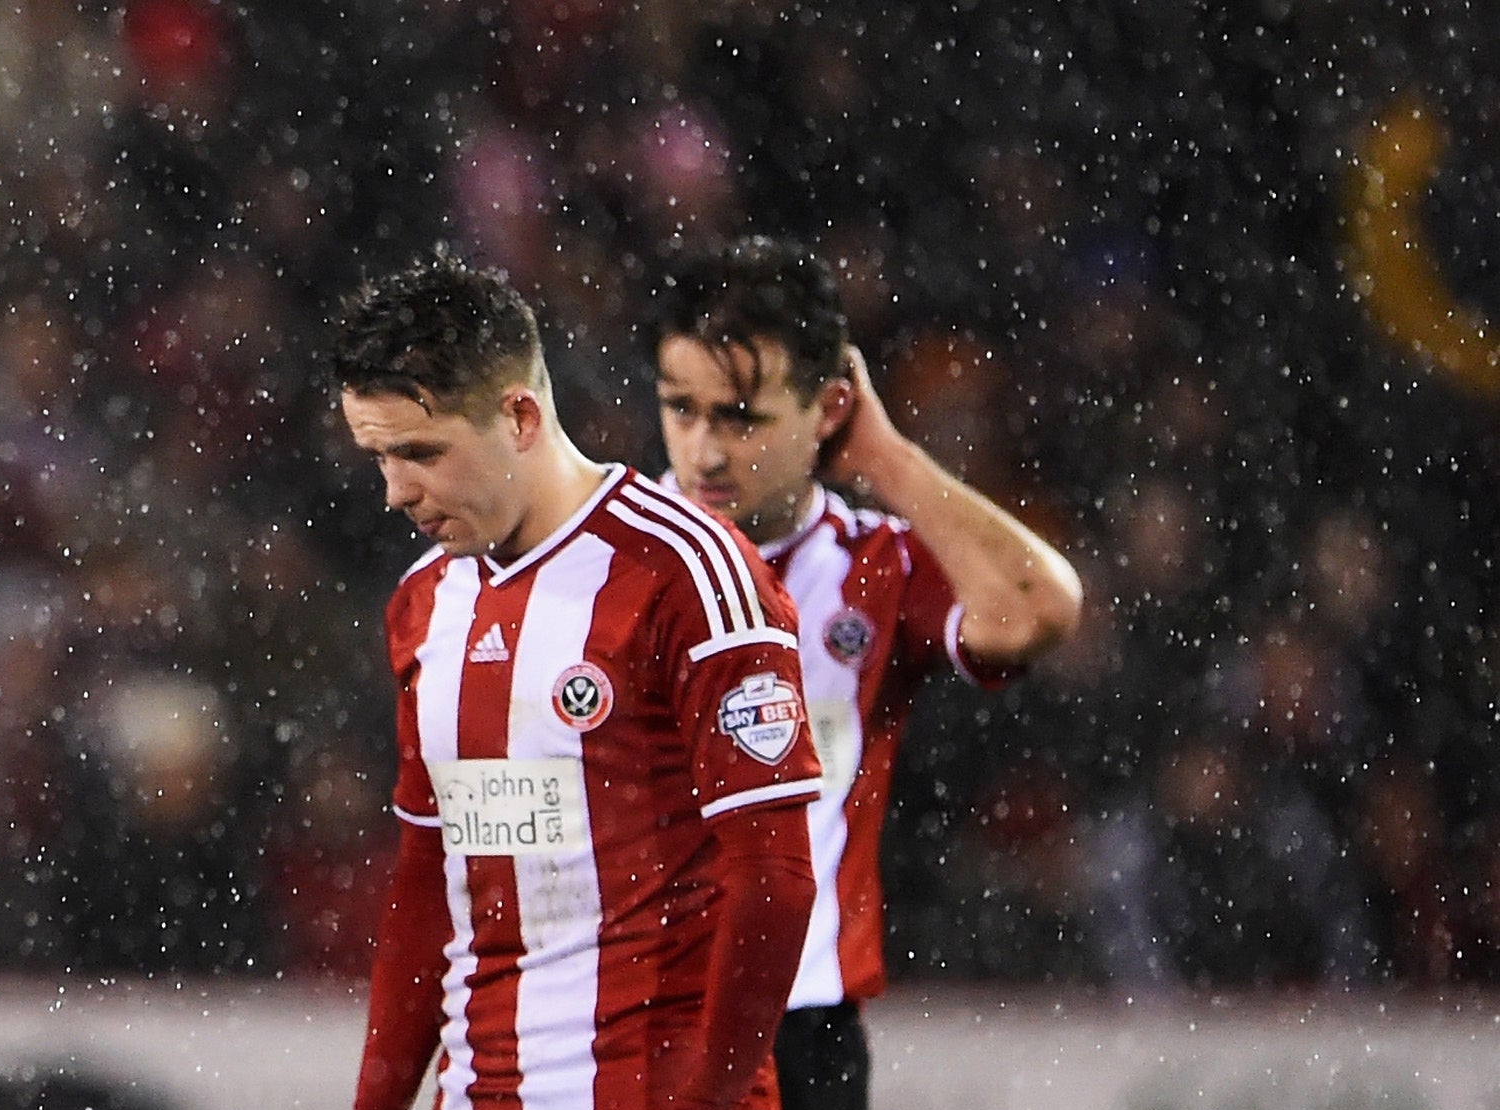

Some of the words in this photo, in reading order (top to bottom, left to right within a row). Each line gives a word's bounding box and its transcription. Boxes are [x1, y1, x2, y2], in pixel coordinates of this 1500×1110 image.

[761, 701, 797, 722] BET
[481, 770, 534, 804] john
[539, 777, 564, 844] sales
[442, 811, 536, 845] olland
